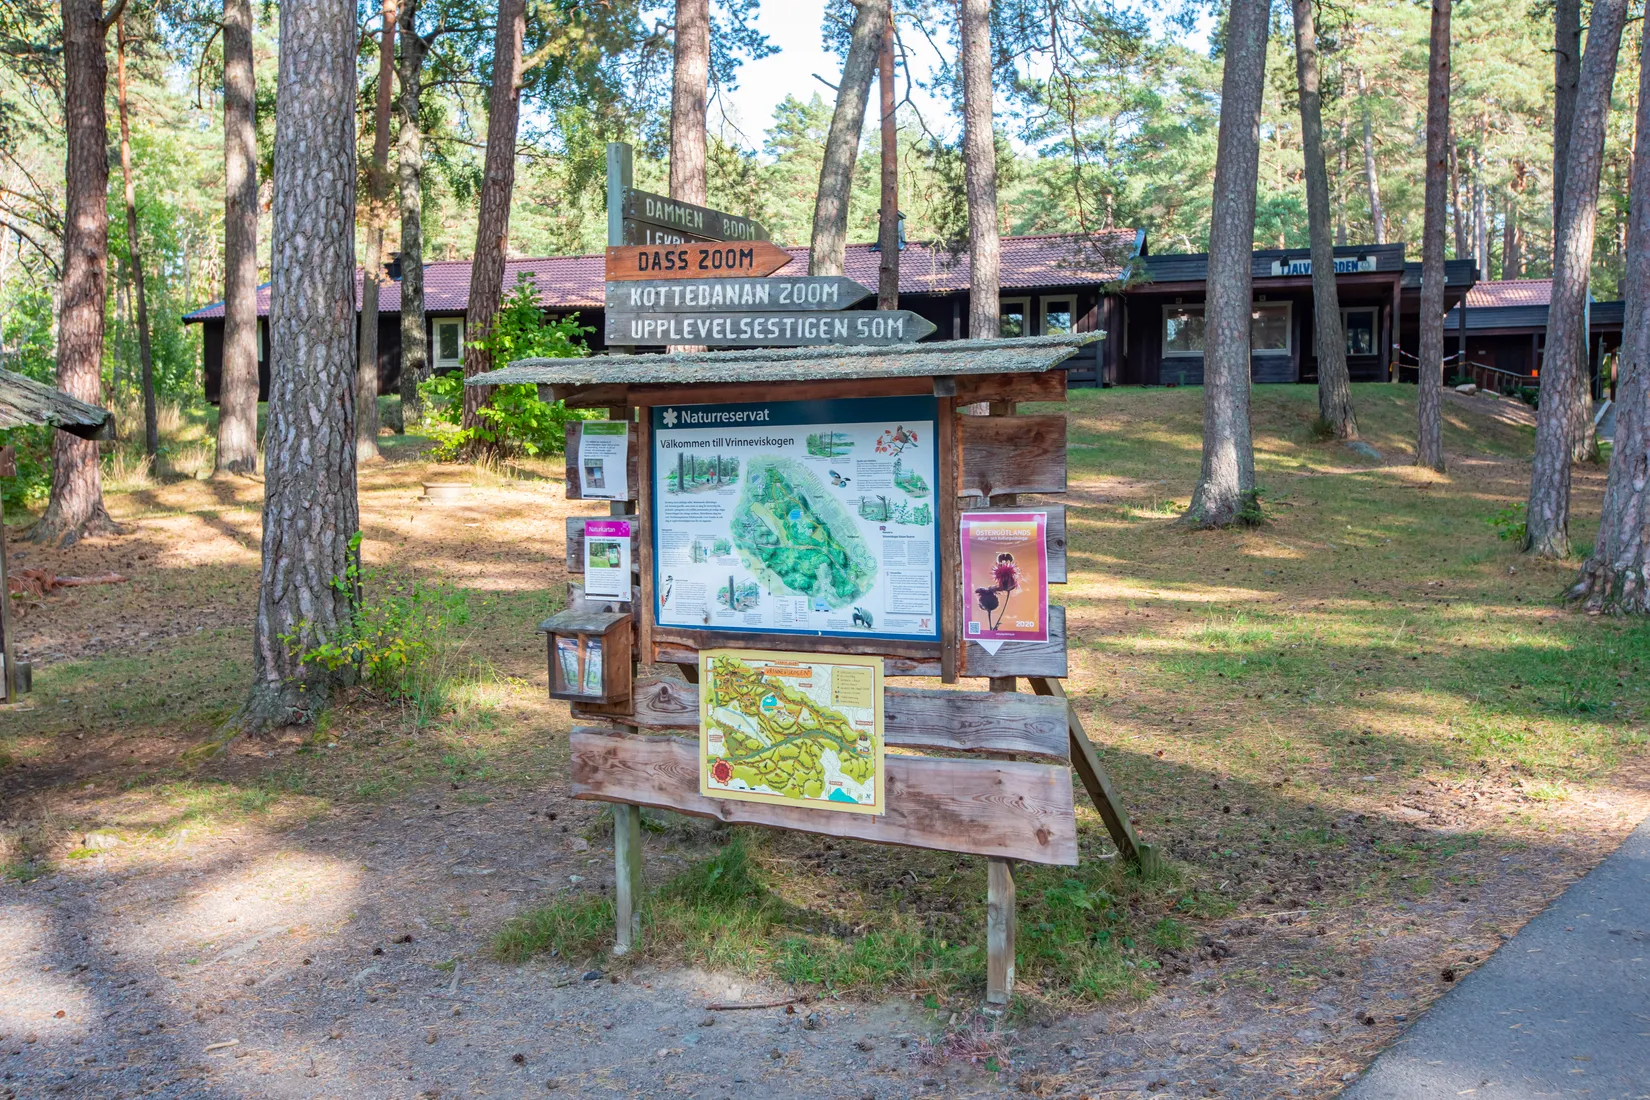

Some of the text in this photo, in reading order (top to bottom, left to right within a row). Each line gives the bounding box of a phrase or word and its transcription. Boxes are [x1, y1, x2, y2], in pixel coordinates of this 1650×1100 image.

[646, 198, 756, 241] DAMMEN 800M
[646, 229, 695, 245] LEKP
[638, 250, 689, 271] DASS
[630, 283, 769, 306] KOTTEBANAN
[631, 316, 903, 339] UPPLEVELSESTIGEN 50M
[681, 408, 770, 424] Naturreservat
[660, 437, 795, 449] Välkommen till Vrinneviskogen
[1015, 620, 1035, 628] 2020
